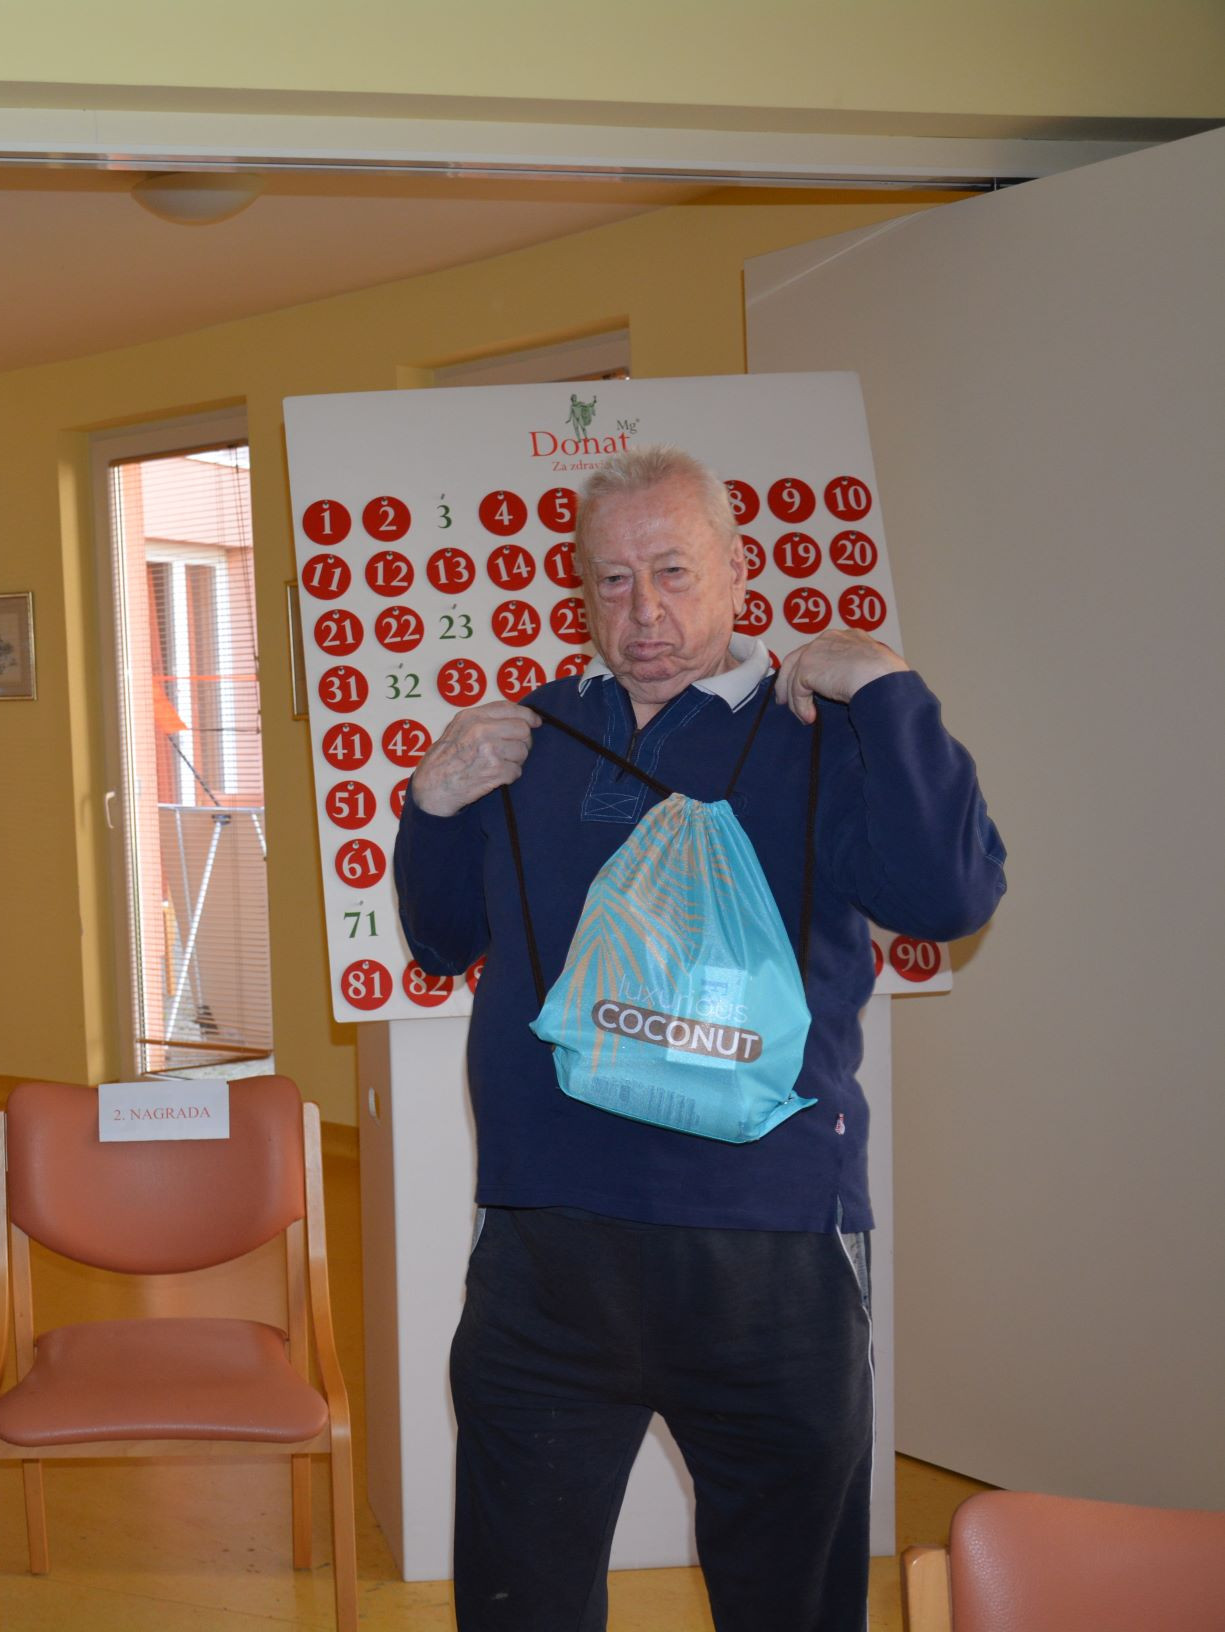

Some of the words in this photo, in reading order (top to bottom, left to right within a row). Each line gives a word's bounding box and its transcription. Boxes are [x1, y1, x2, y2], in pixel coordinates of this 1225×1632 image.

[529, 431, 631, 457] Donat
[552, 461, 567, 472] Za
[321, 510, 333, 534] 1
[378, 507, 397, 531] 2
[438, 504, 452, 529] 3
[494, 501, 514, 526] 4
[554, 498, 571, 523] 5
[728, 489, 746, 515] 8
[781, 488, 801, 514] 9
[833, 485, 867, 512] 10
[309, 562, 343, 591] 11
[374, 560, 409, 587] 12
[434, 557, 470, 584] 13
[495, 552, 531, 582] 14
[743, 544, 761, 570] 8
[781, 542, 816, 568] 19
[837, 540, 872, 567] 20
[321, 618, 356, 647] 21
[382, 615, 420, 644] 22
[439, 614, 473, 640] 23
[499, 608, 536, 638] 24
[557, 608, 589, 634] 25
[790, 597, 826, 624] 29
[846, 595, 881, 622] 30
[326, 674, 360, 703] 31
[385, 673, 422, 700] 32
[444, 669, 481, 696] 33
[504, 667, 539, 694] 34
[328, 733, 364, 760] 41
[387, 730, 426, 757] 42
[333, 791, 367, 819] 51
[342, 848, 379, 879] 61
[343, 909, 379, 939] 71
[348, 971, 384, 1000] 81
[409, 967, 448, 996] 82
[896, 942, 935, 972] 90
[597, 1003, 760, 1059] COCONUT
[113, 1109, 126, 1121] 2.
[130, 1106, 211, 1121] NAGRADA
